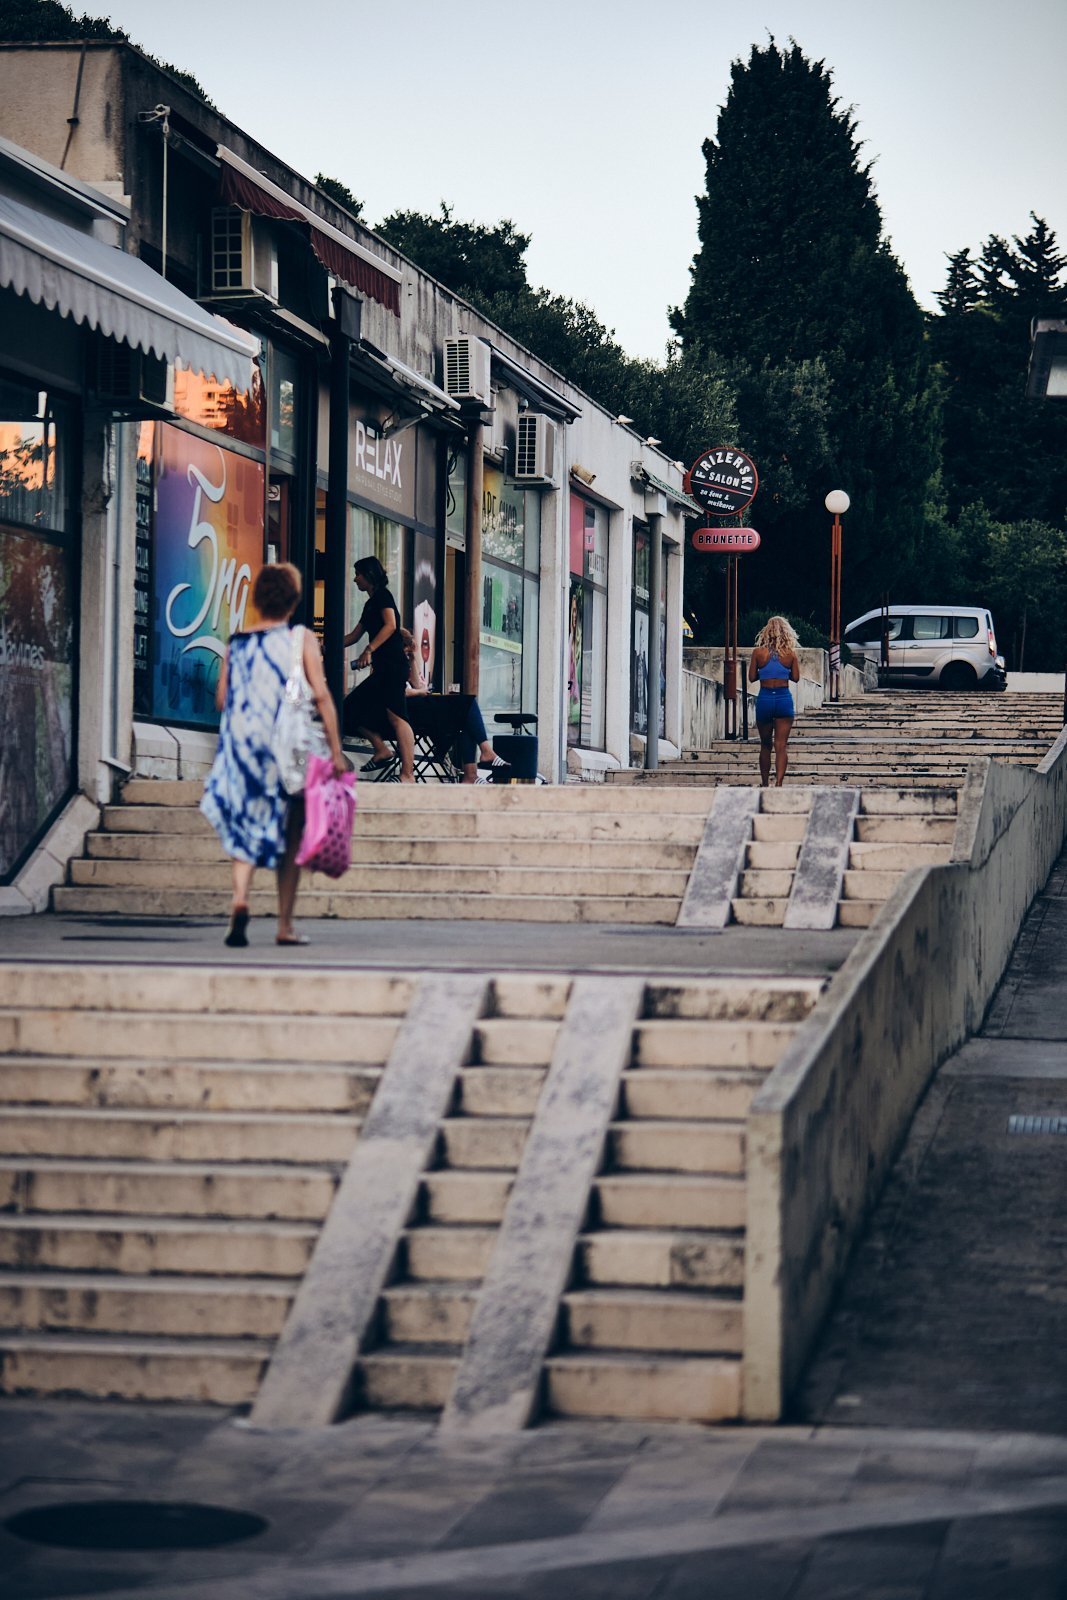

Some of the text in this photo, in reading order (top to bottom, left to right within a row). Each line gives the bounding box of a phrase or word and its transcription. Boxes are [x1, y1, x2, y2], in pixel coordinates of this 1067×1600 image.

[355, 420, 402, 489] RELAX
[695, 451, 753, 491] FRIZERSKI
[708, 471, 740, 487] SALON
[698, 535, 753, 544] BRUNETTE
